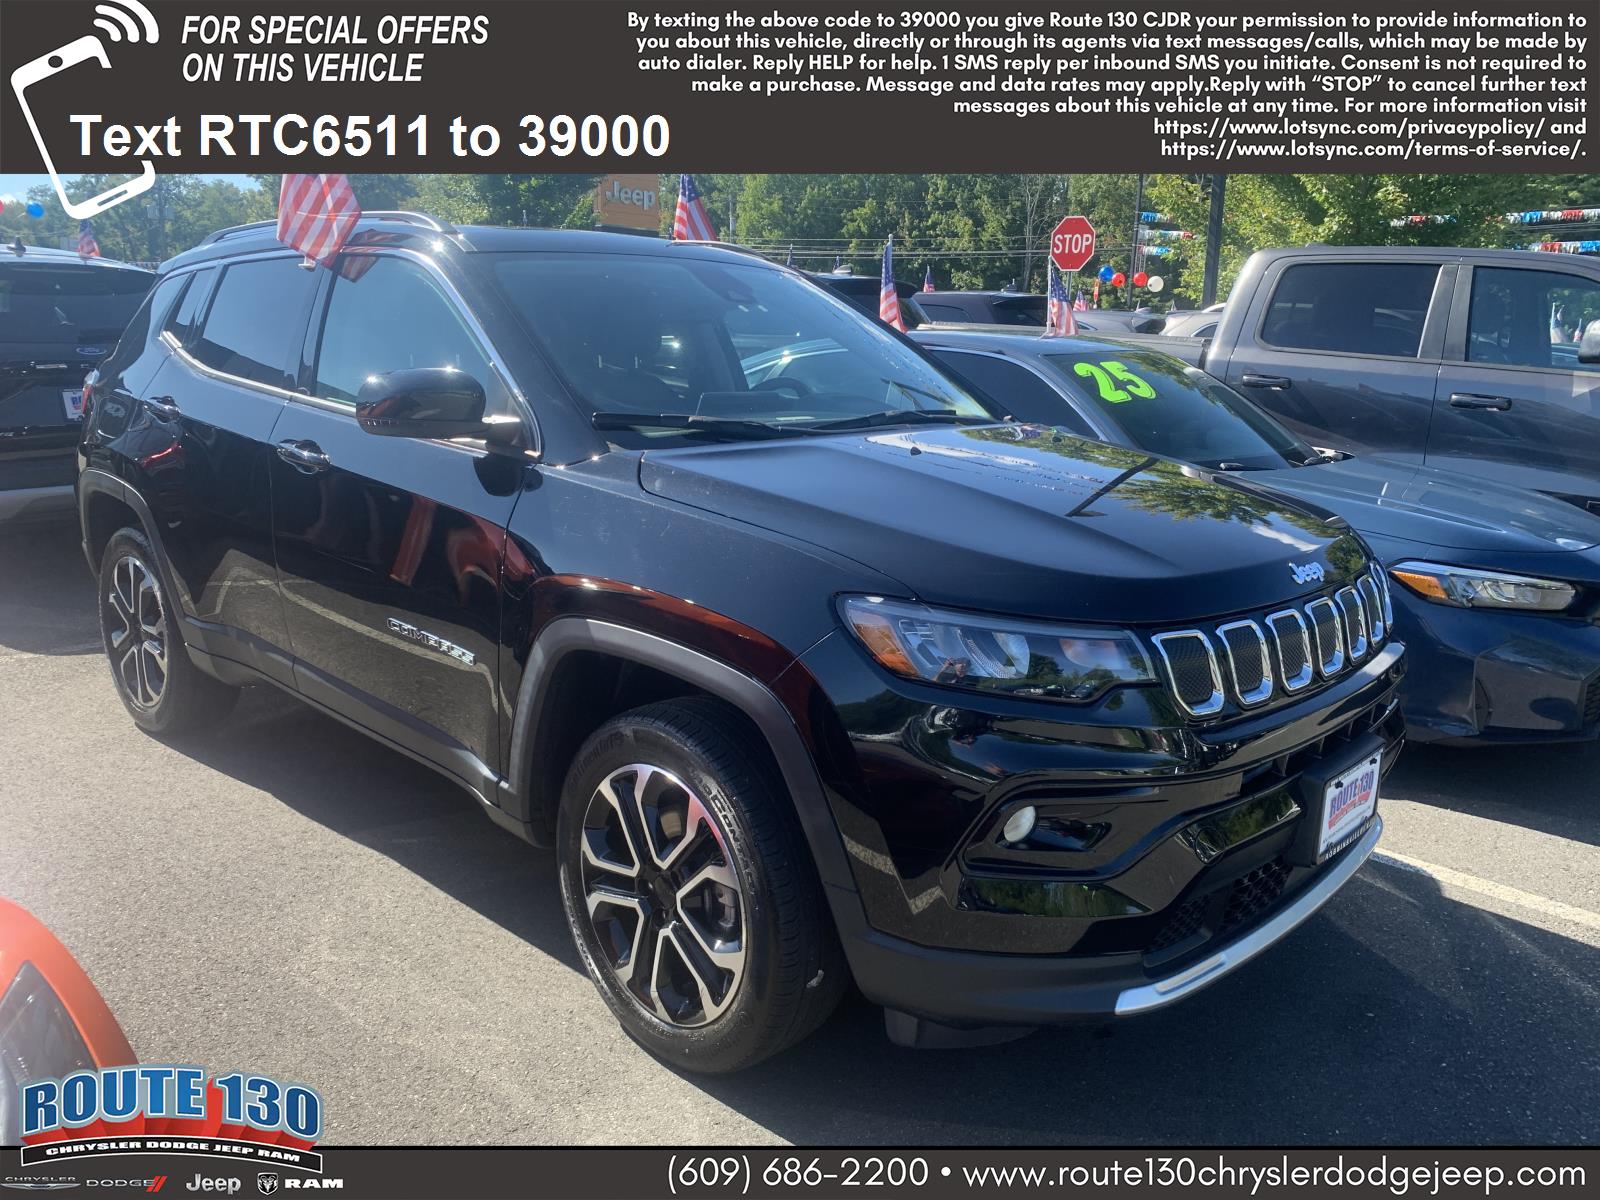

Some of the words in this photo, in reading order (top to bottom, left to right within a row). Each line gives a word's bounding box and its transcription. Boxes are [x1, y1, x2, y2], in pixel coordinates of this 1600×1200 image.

[606, 181, 656, 210] Jeep
[1053, 233, 1092, 254] STOP
[1073, 361, 1157, 404] 25
[1289, 561, 1325, 585] Jeep
[1329, 778, 1359, 819] ROUTE
[1359, 769, 1375, 794] 130
